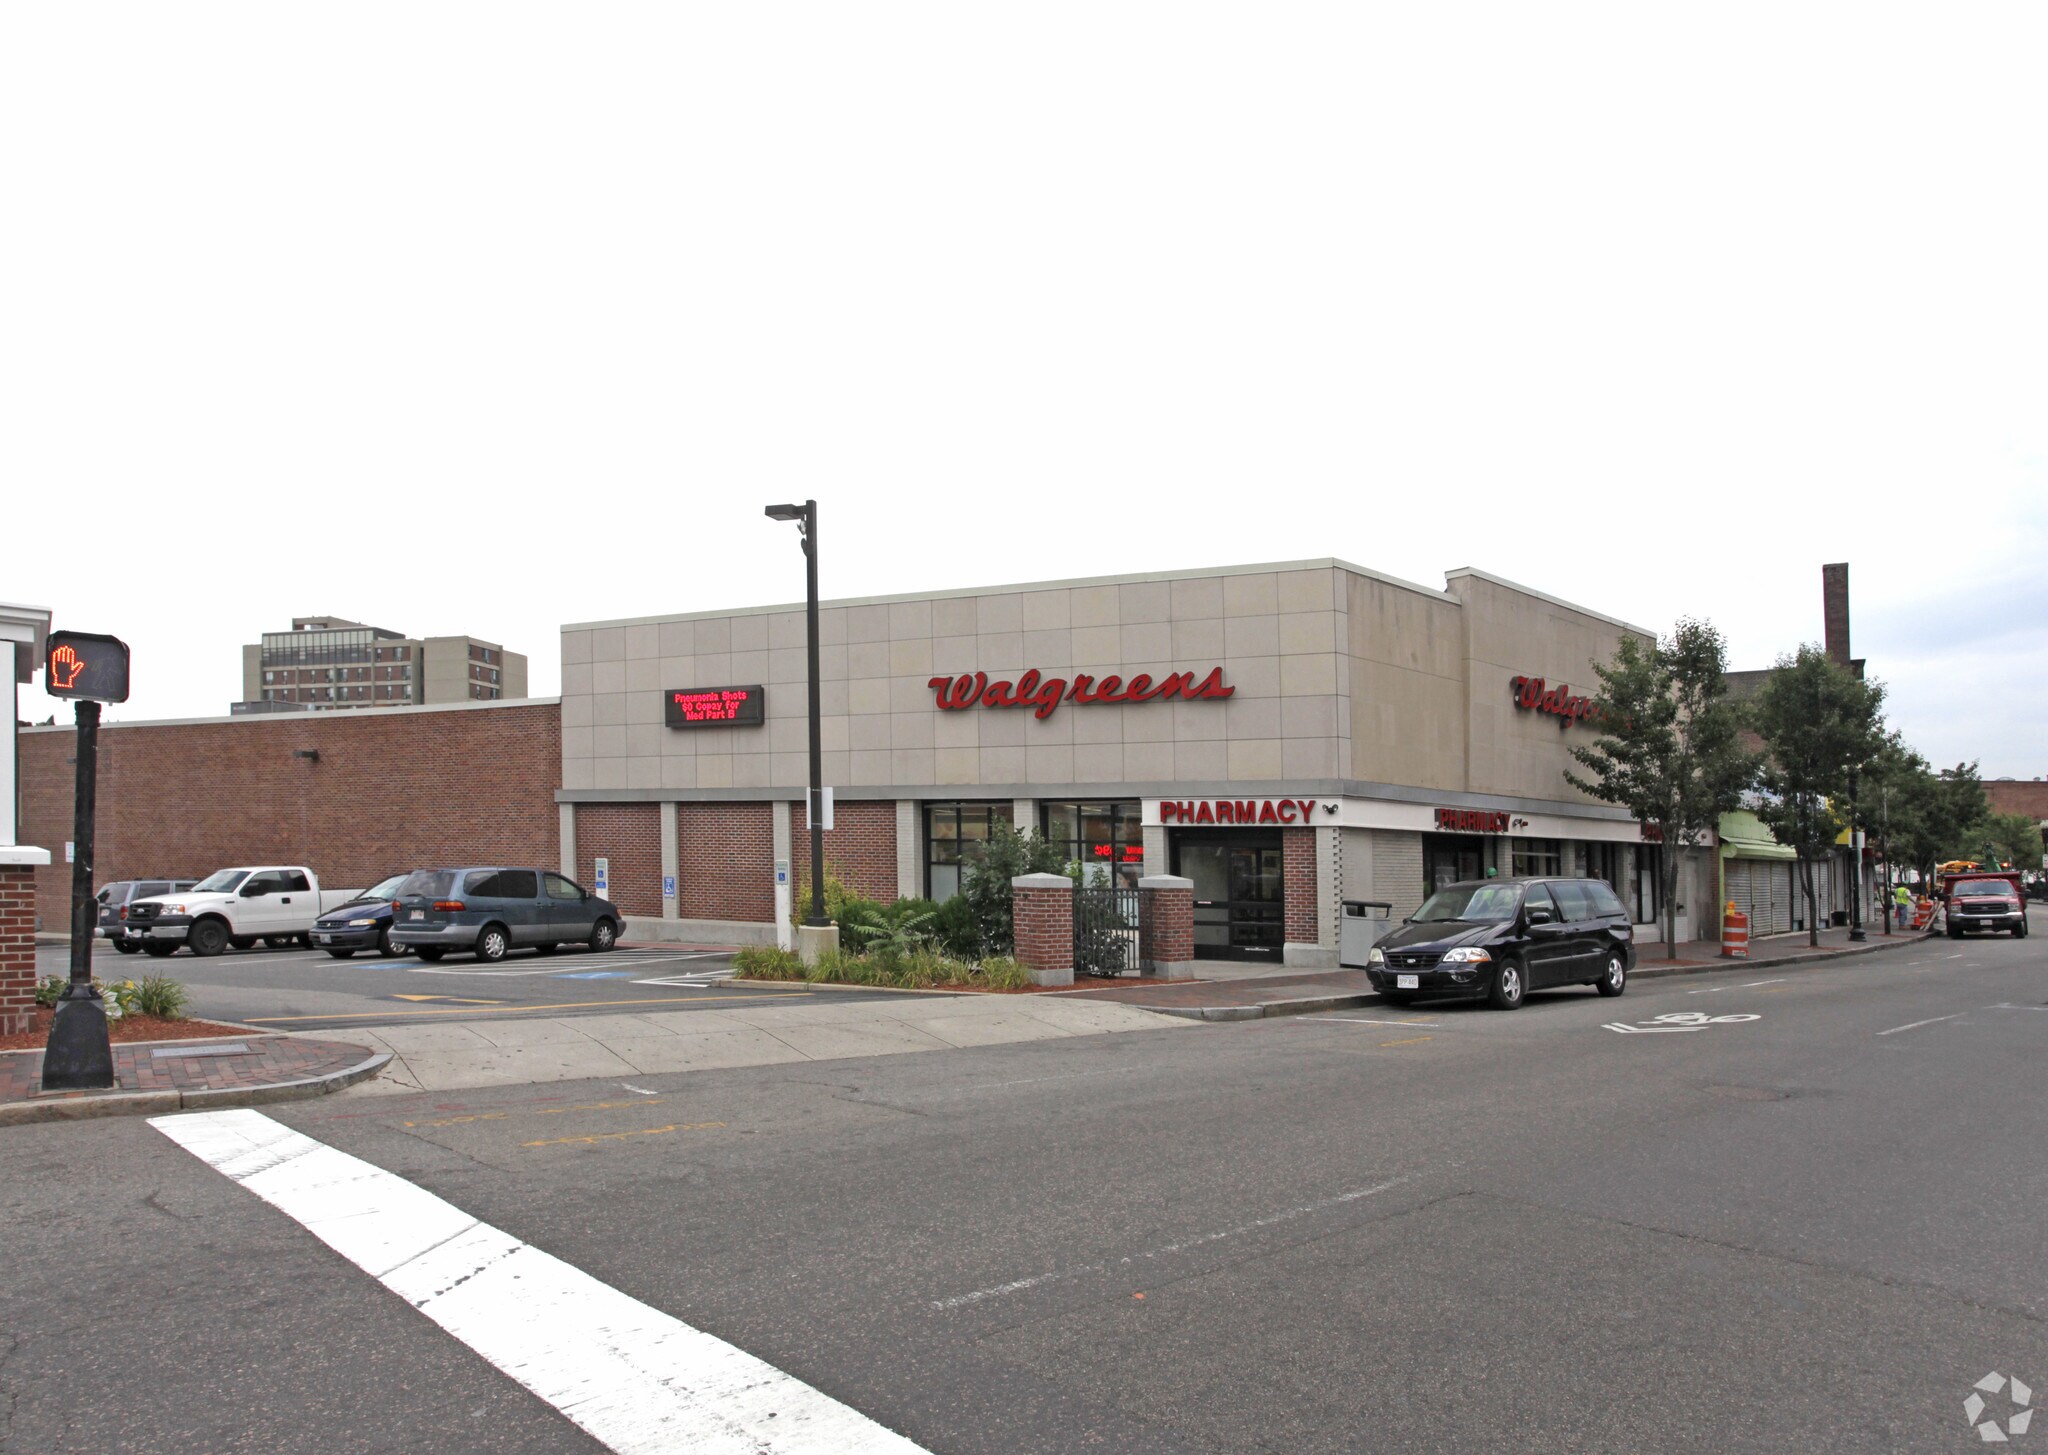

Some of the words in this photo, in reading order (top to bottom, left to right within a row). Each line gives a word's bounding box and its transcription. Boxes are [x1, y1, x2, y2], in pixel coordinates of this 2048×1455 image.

[675, 692, 718, 703] Pneumonia
[721, 690, 747, 701] Shots
[928, 666, 1235, 719] Walgreens
[682, 703, 693, 712] $0
[695, 702, 722, 711] Copay
[725, 700, 740, 710] for
[686, 711, 704, 720] Med
[706, 710, 725, 719] Part
[727, 710, 735, 718] B
[1160, 799, 1316, 824] PHARMACY
[1437, 808, 1511, 832] PHARMACY
